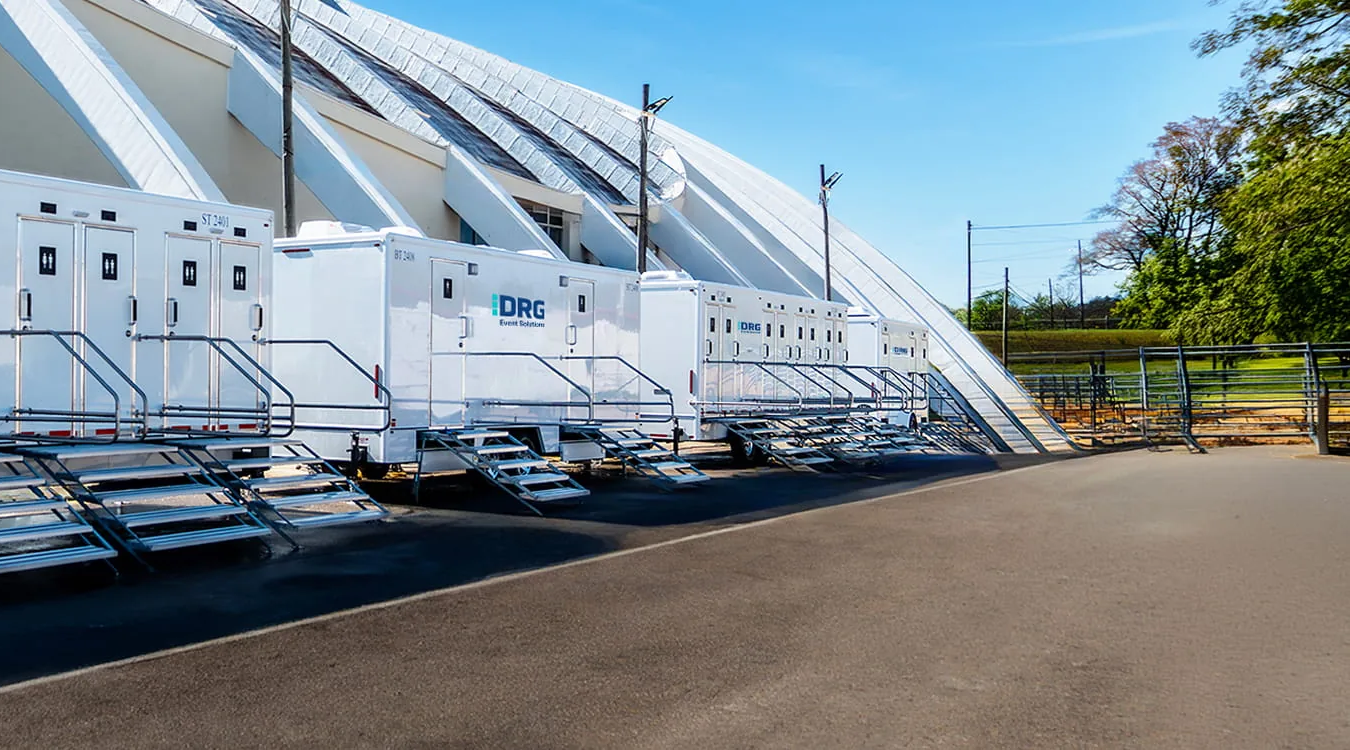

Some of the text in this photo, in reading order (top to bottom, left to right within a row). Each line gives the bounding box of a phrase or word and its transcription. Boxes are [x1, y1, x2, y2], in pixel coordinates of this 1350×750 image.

[202, 213, 211, 225] ST
[500, 294, 545, 319] DRG
[741, 322, 761, 331] DRG
